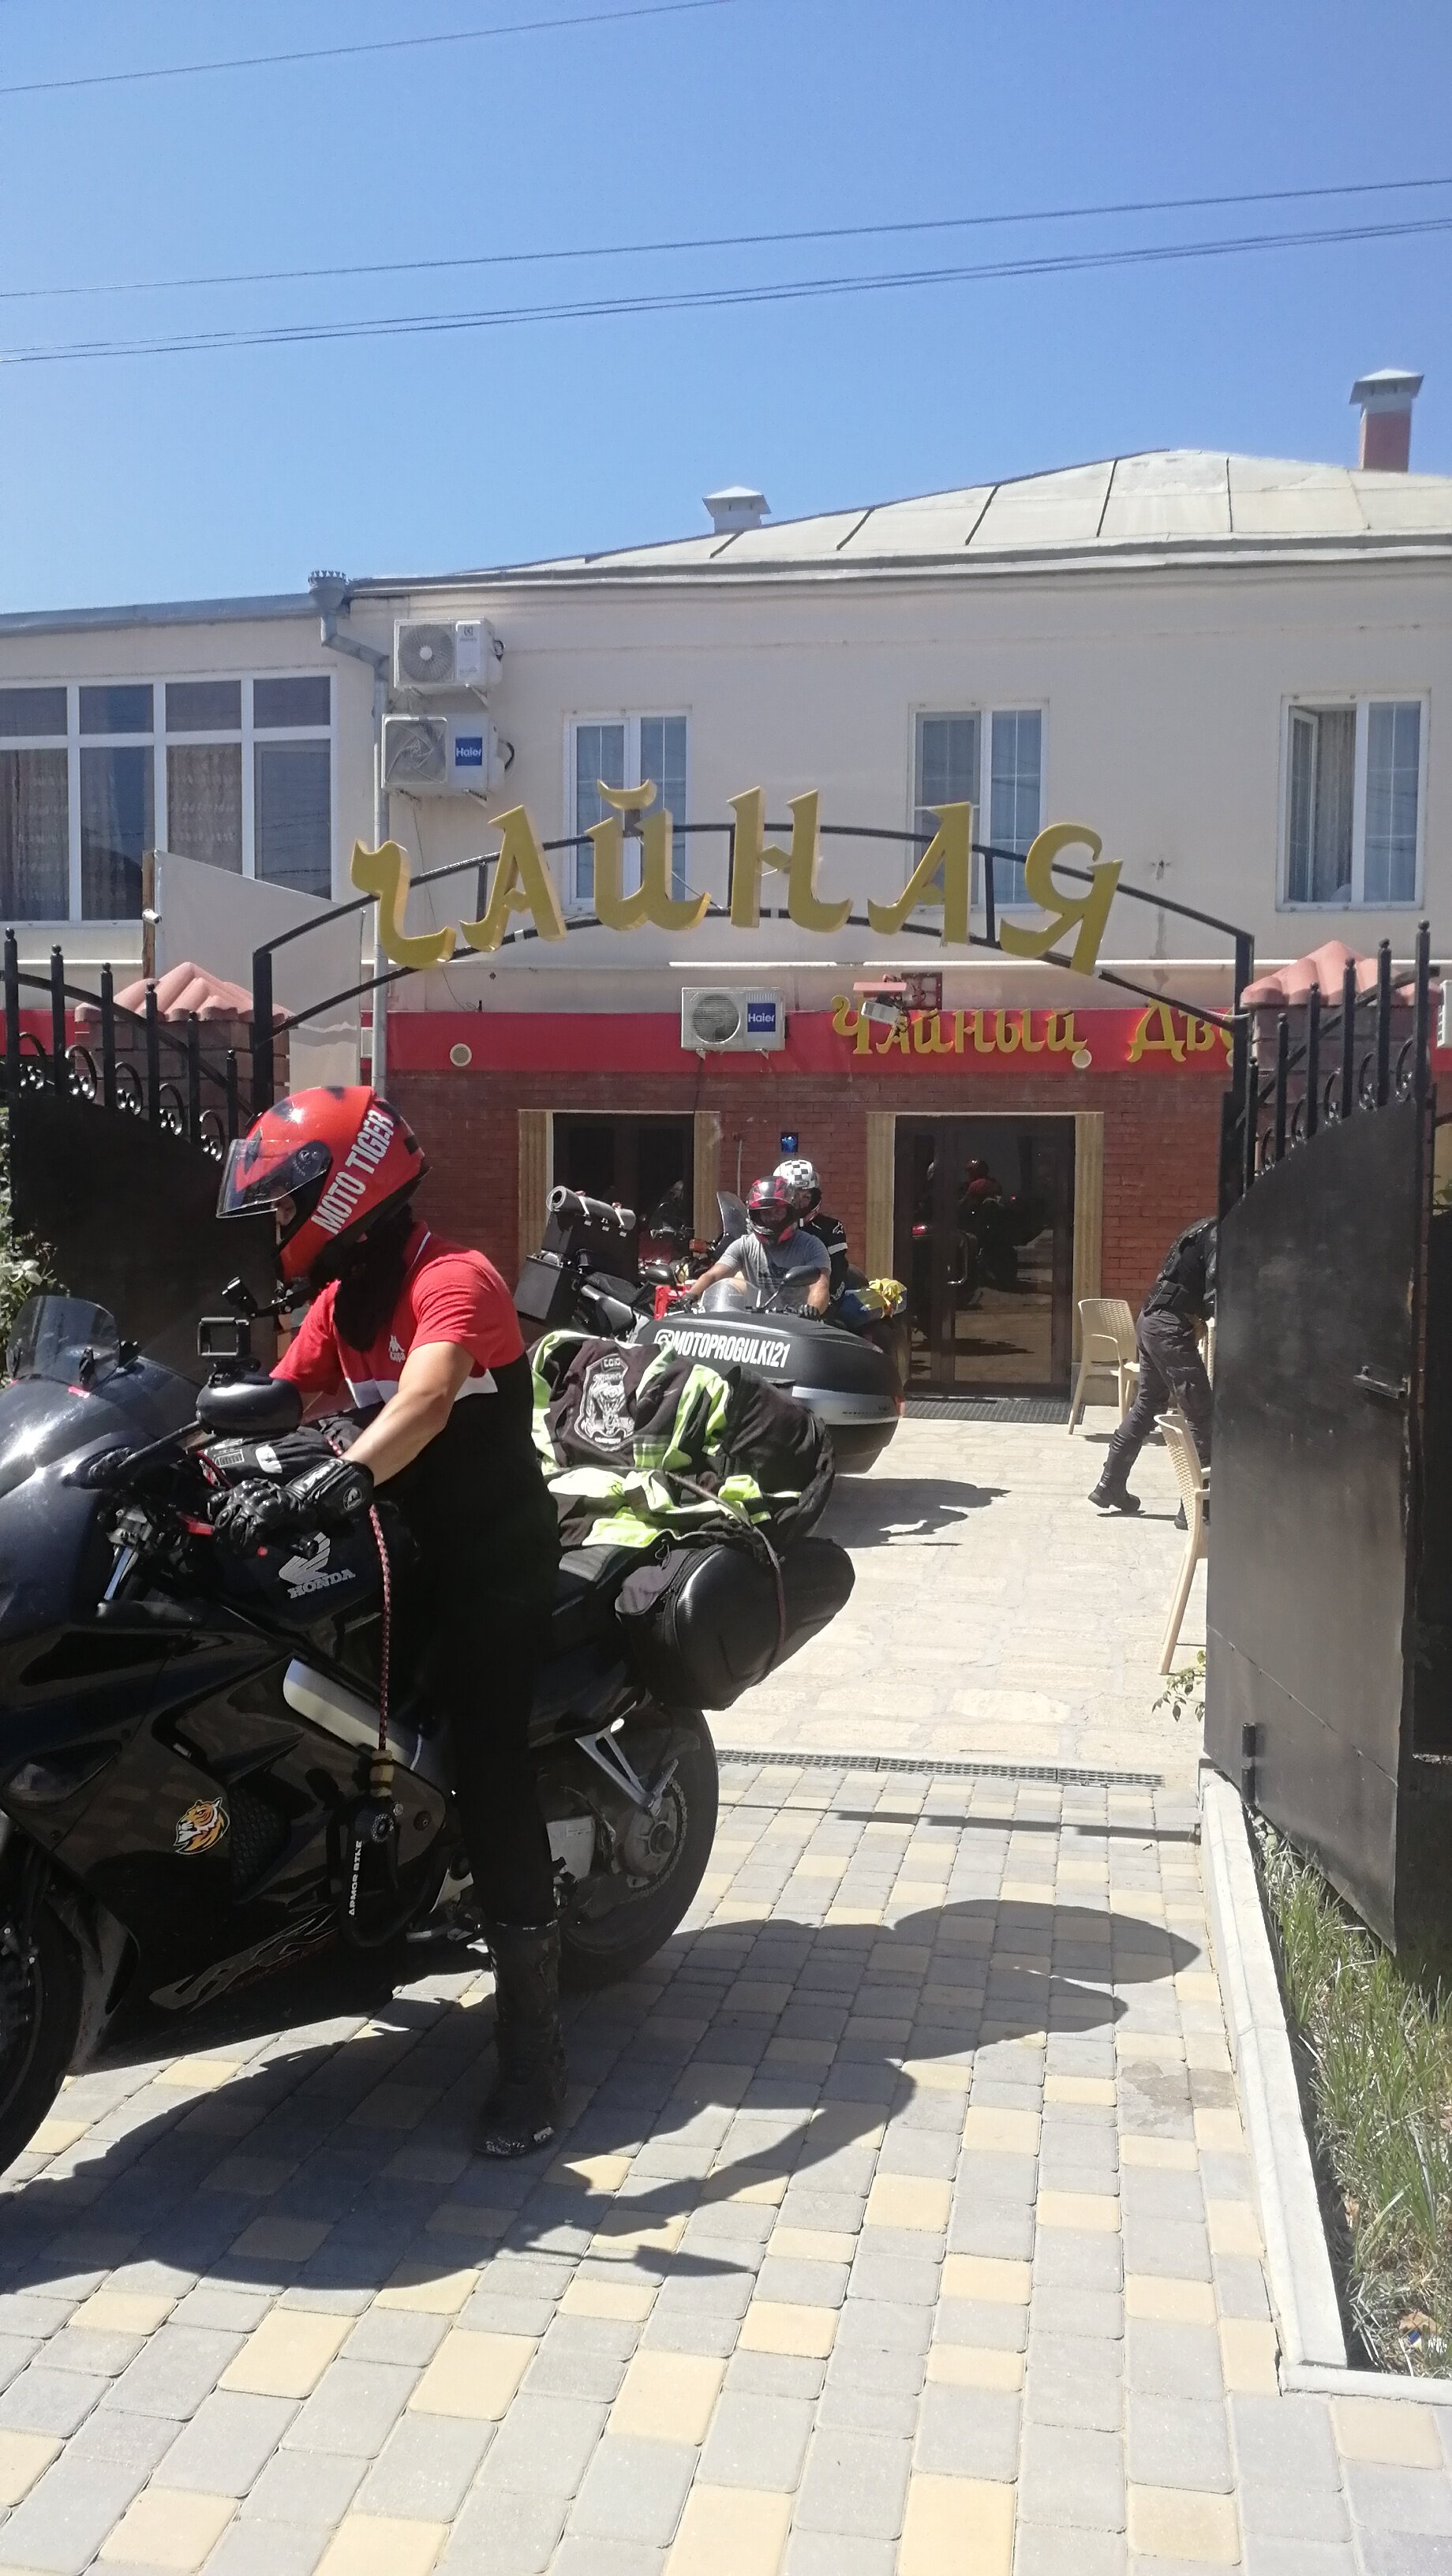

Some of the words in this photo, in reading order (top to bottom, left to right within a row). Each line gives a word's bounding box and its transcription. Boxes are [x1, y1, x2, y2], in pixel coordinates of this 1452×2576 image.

[456, 747, 481, 758] Haier
[748, 1013, 775, 1023] Haier
[310, 1171, 366, 1235] MOTO
[345, 1109, 395, 1174] TIGER
[286, 1568, 356, 1599] HONDA
[348, 1874, 359, 1916] ARMOR
